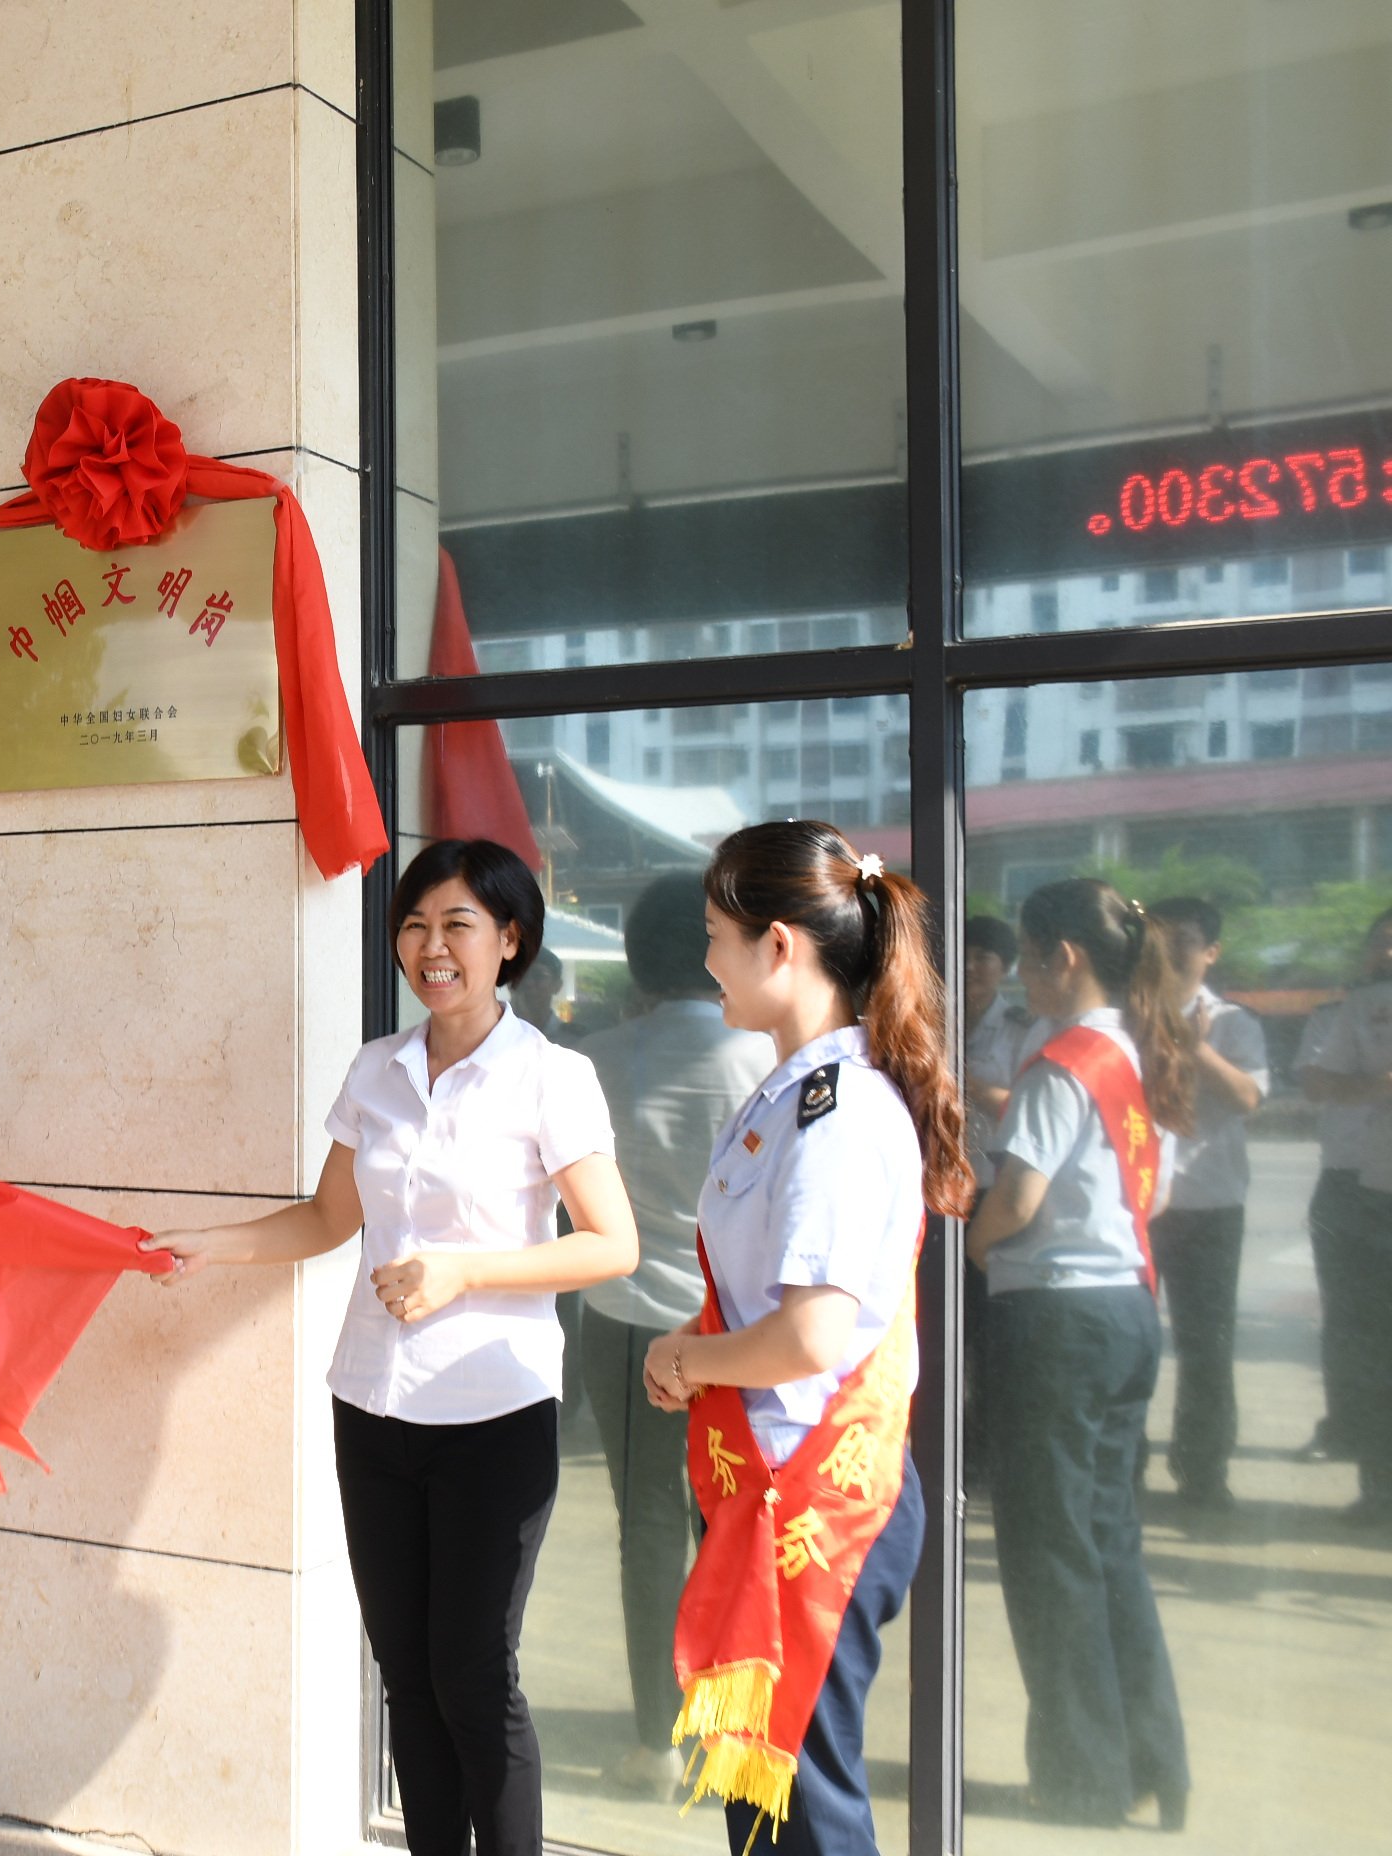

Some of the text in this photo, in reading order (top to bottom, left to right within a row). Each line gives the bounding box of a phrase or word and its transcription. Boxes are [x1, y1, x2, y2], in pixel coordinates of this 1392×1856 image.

[8, 563, 234, 662] 巾帼文明岗
[60, 704, 179, 728] 中华全国妇女联合会
